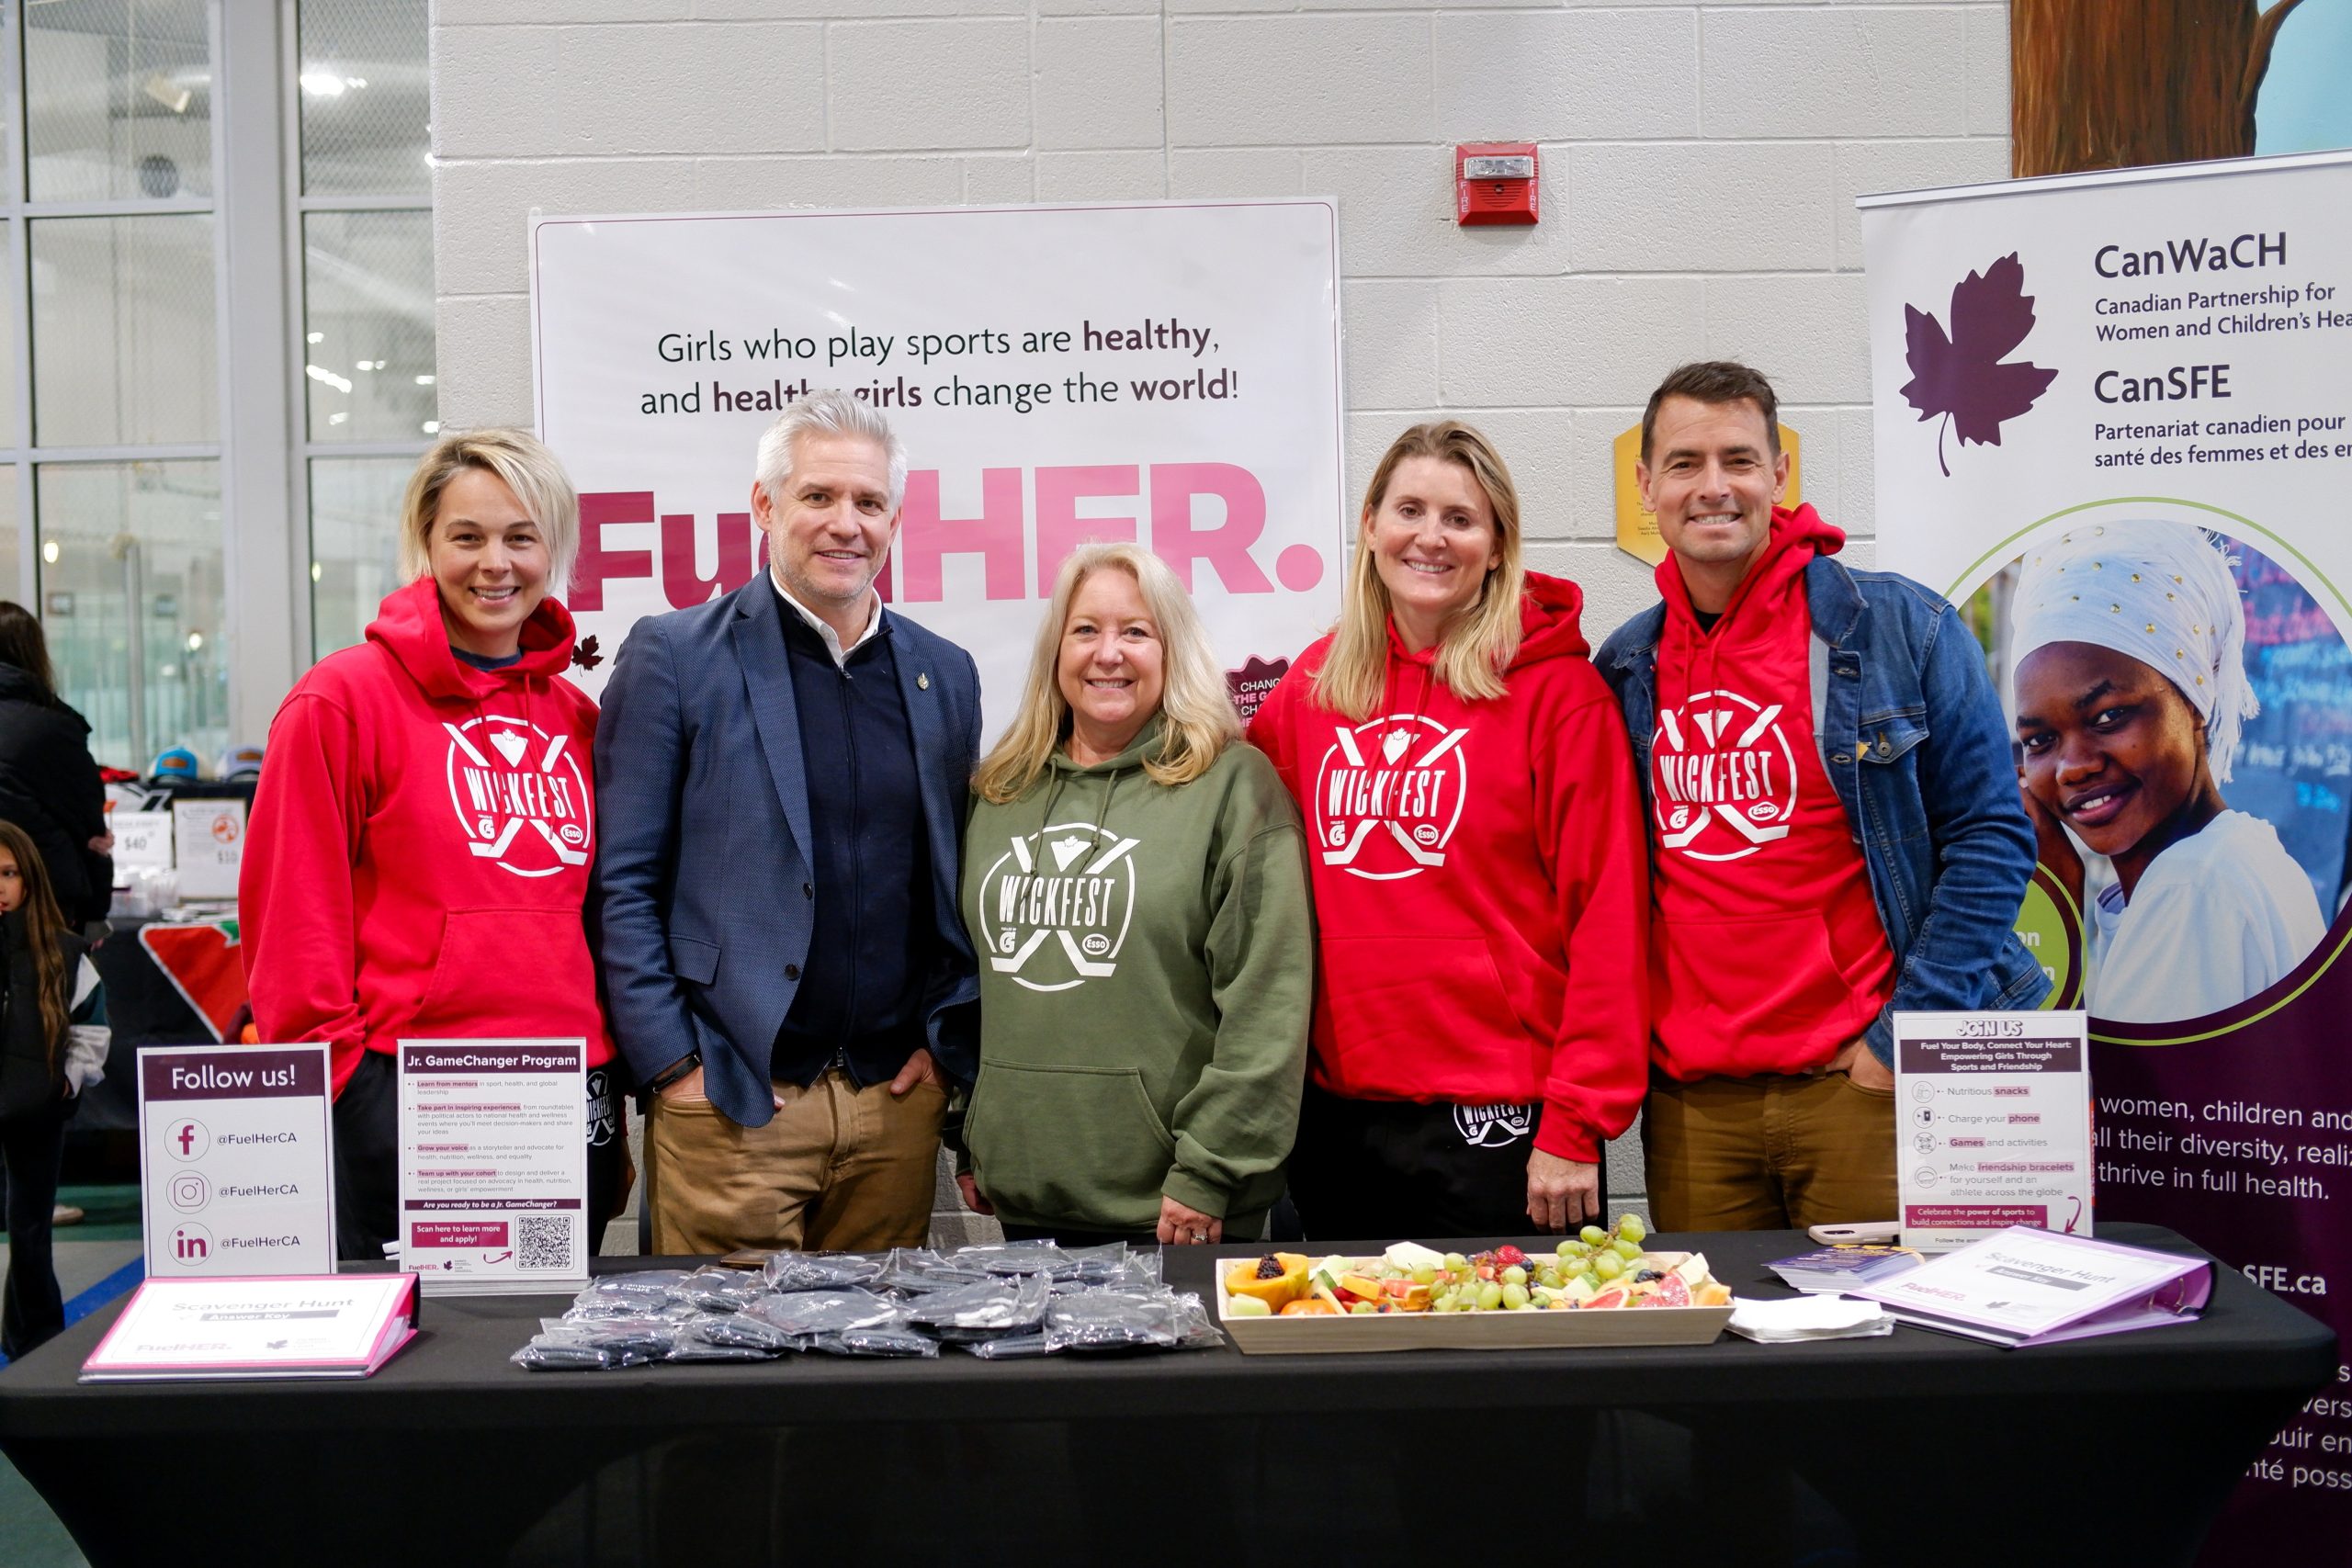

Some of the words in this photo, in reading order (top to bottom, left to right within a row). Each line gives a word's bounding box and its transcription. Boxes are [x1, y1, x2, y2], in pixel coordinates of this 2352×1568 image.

[1461, 181, 1469, 213] FIRE
[2095, 231, 2287, 278] CanWaCH
[2095, 291, 2181, 315] Canadian
[2188, 284, 2299, 310] Partnership
[2305, 282, 2335, 302] for
[2096, 321, 2169, 342] Women
[2176, 317, 2211, 337] and
[658, 330, 731, 363] Girls
[743, 327, 817, 360] who
[827, 324, 895, 367] play
[907, 326, 1012, 364] sports
[1022, 326, 1071, 355] are
[1083, 318, 1221, 357] healthy,
[2095, 364, 2232, 404] CanSFE
[640, 382, 702, 415] and
[712, 378, 841, 412] healt
[933, 377, 1052, 414] change
[1064, 374, 1119, 404] the
[1129, 369, 1239, 402] world!
[2095, 420, 2200, 441] Partenariat
[2206, 414, 2291, 437] canadien
[2297, 414, 2346, 438] pour
[2095, 447, 2145, 468] santé
[2150, 444, 2183, 465] des
[2188, 442, 2265, 463] femmes
[2269, 443, 2290, 459] et
[2295, 439, 2329, 458] des
[567, 463, 1324, 613] FuHER.
[1233, 693, 1257, 705] THE
[1659, 750, 1774, 803] WICKFEST
[999, 874, 1115, 927] WICKFEST
[1999, 1020, 2023, 1036] US
[407, 1055, 423, 1066] Jr.
[425, 1055, 519, 1069] GameChanger
[522, 1055, 577, 1068] Program
[1940, 1053, 1994, 1062] Empowering
[2016, 1052, 2052, 1060] Through
[1951, 1064, 1978, 1072] Sports
[1997, 1063, 2043, 1072] Friendship
[172, 1065, 254, 1090] Follow
[261, 1064, 296, 1087] us!
[1947, 1088, 1993, 1096] Nutritious
[1995, 1087, 2029, 1095] snacks
[1948, 1114, 1983, 1124] Charge
[1984, 1116, 2006, 1124] your
[2008, 1113, 2041, 1124] phone
[2099, 1097, 2195, 1122] women,
[2202, 1100, 2302, 1126] children
[216, 1132, 298, 1146] @FuelHerCA
[1950, 1138, 1984, 1146] Games
[1986, 1138, 2005, 1146] and
[2007, 1138, 2048, 1146] activities
[2118, 1129, 2173, 1151] their
[2180, 1133, 2289, 1166] diversity,
[1949, 1163, 1975, 1172] Make
[1977, 1163, 2027, 1173] friendship
[2029, 1163, 2075, 1172] bracelets
[1950, 1176, 1962, 1184] for
[1964, 1176, 2003, 1186] yourself
[2005, 1176, 2023, 1184] and
[2098, 1162, 2165, 1187] thrive
[2173, 1167, 2193, 1189] in
[2201, 1168, 2236, 1192] full
[2245, 1172, 2329, 1200] health.
[218, 1184, 299, 1198] @FuelHerCA
[1951, 1188, 1982, 1197] athlete
[1984, 1189, 2016, 1197] across
[2018, 1188, 2034, 1196] the
[2036, 1188, 2064, 1198] globe
[450, 1201, 470, 1210] ready
[496, 1201, 504, 1209] Jr.
[505, 1201, 558, 1209] GameChanger?
[1917, 1208, 1952, 1216] Celebrate
[1953, 1208, 1966, 1216] the
[1967, 1209, 1991, 1217] power
[1992, 1208, 2001, 1216] of
[2001, 1209, 2026, 1217] sports
[435, 1224, 451, 1233] here
[462, 1224, 481, 1233] learn
[1911, 1218, 1930, 1226] build
[1931, 1218, 1974, 1226] connections
[1976, 1218, 1990, 1226] and
[1991, 1218, 2014, 1227] inspire
[2017, 1219, 2042, 1227] change
[220, 1235, 300, 1250] @FuelHerCA
[455, 1235, 478, 1245] apply!
[1984, 1252, 2071, 1276] Scavenger
[2071, 1269, 2117, 1284] Hunt
[172, 1301, 293, 1312] Scavenger
[299, 1298, 355, 1308] Hunt
